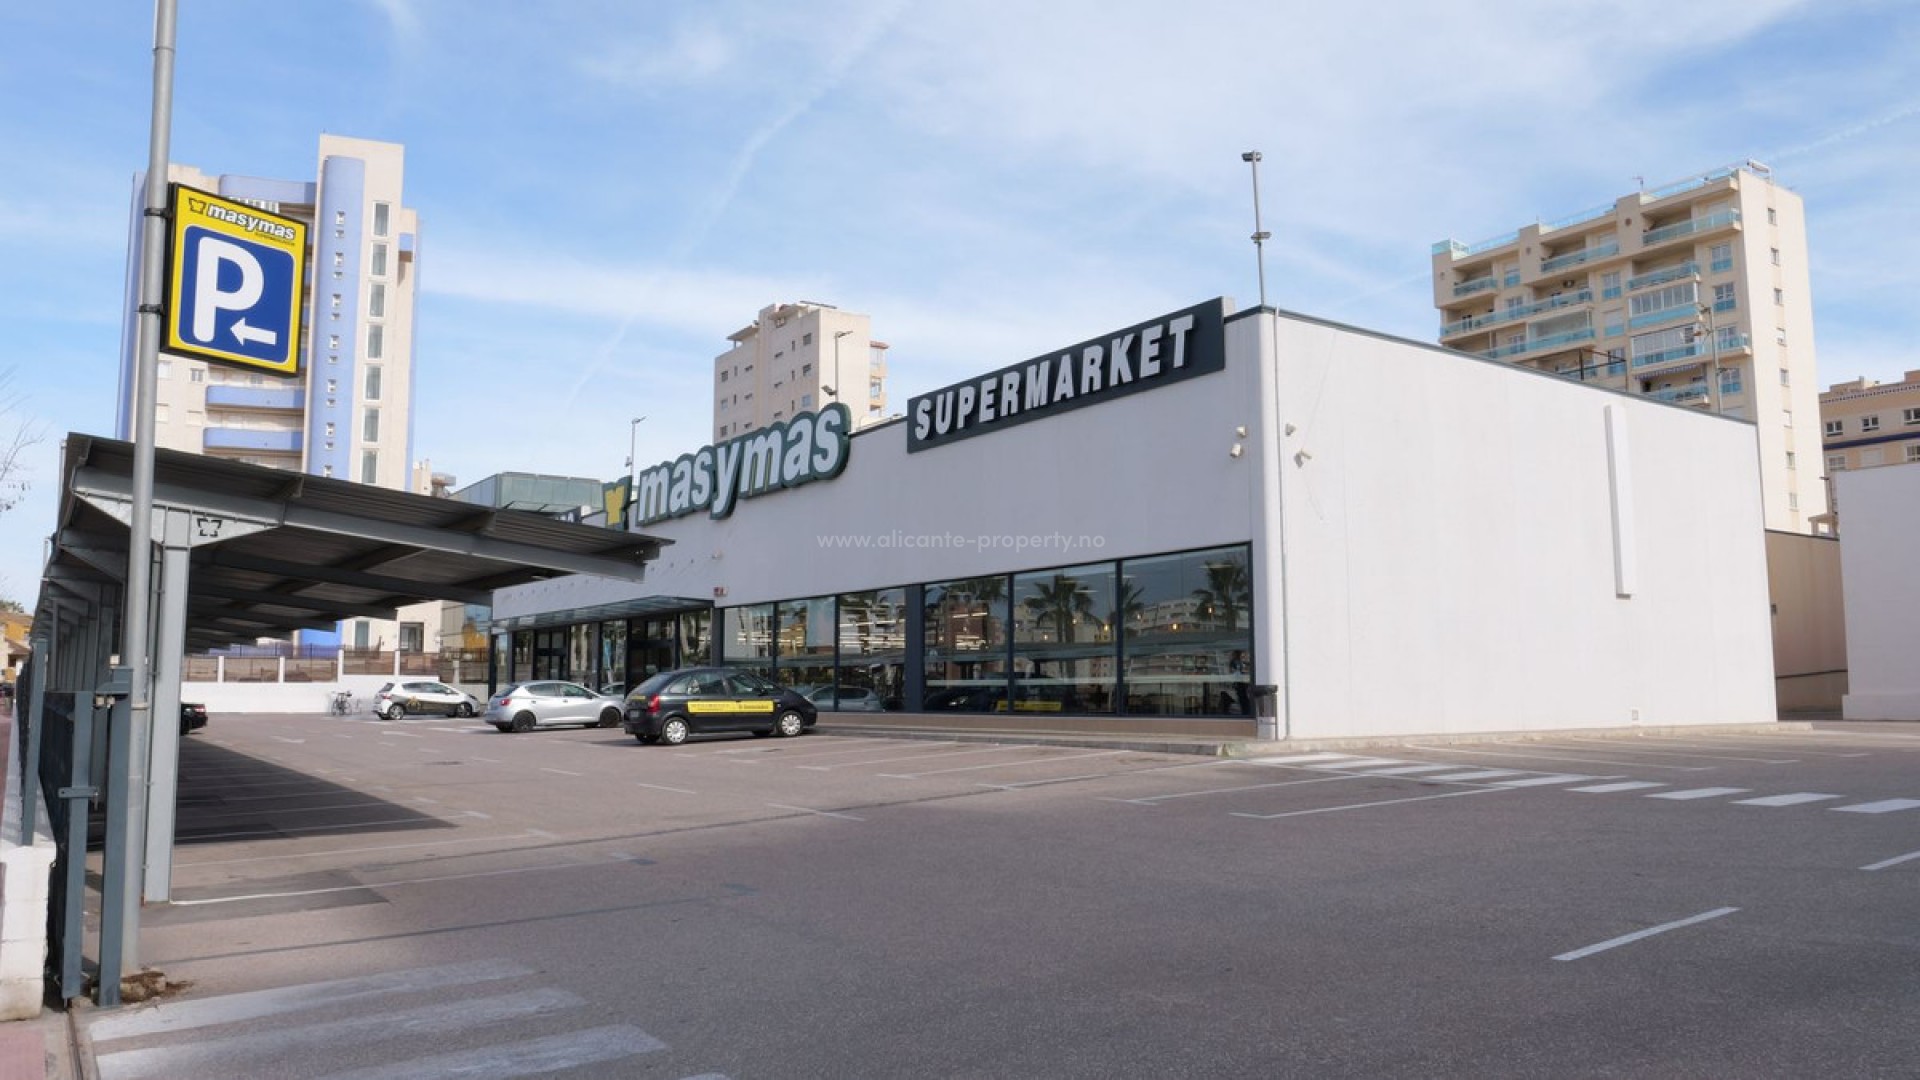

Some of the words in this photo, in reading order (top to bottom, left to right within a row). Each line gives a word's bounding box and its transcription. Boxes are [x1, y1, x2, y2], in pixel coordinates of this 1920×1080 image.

[207, 203, 296, 240] masymas
[193, 236, 265, 343] P
[915, 314, 1195, 441] SUPERMARKET
[637, 407, 843, 524] masymas
